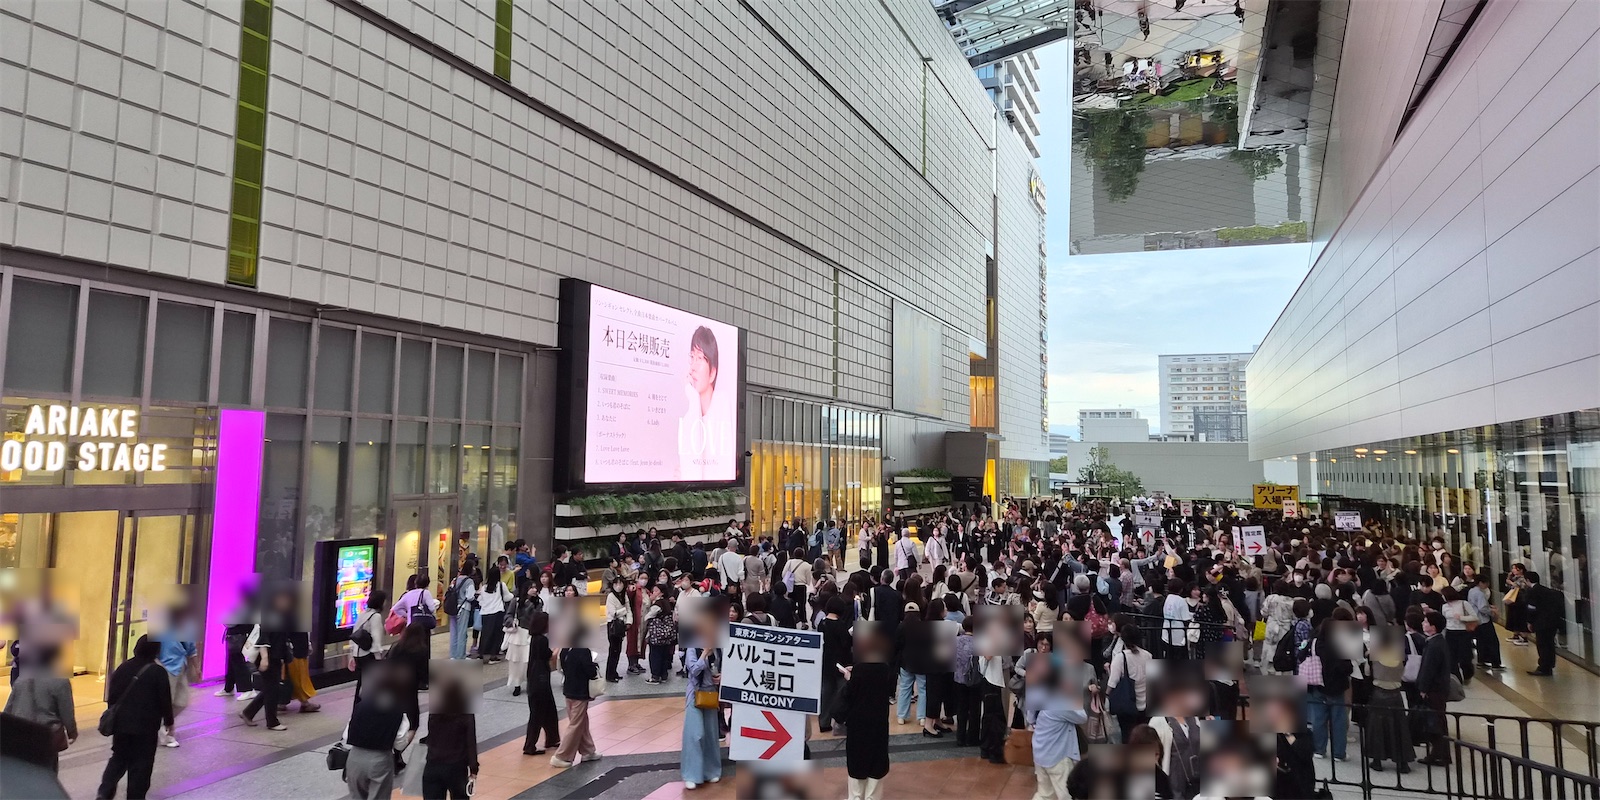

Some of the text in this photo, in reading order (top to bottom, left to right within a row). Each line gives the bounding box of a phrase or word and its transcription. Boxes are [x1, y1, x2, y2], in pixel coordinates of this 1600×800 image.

[602, 325, 670, 358] 本日会場販売
[25, 404, 137, 437] ARIAKE
[1, 440, 168, 472] OOD STAGE
[1257, 486, 1296, 495] アリーナ
[735, 628, 810, 644] 東京ガーデンシアター
[727, 643, 815, 668] バルコニー
[743, 668, 794, 692] 入場口
[741, 690, 795, 708] BALCONY
